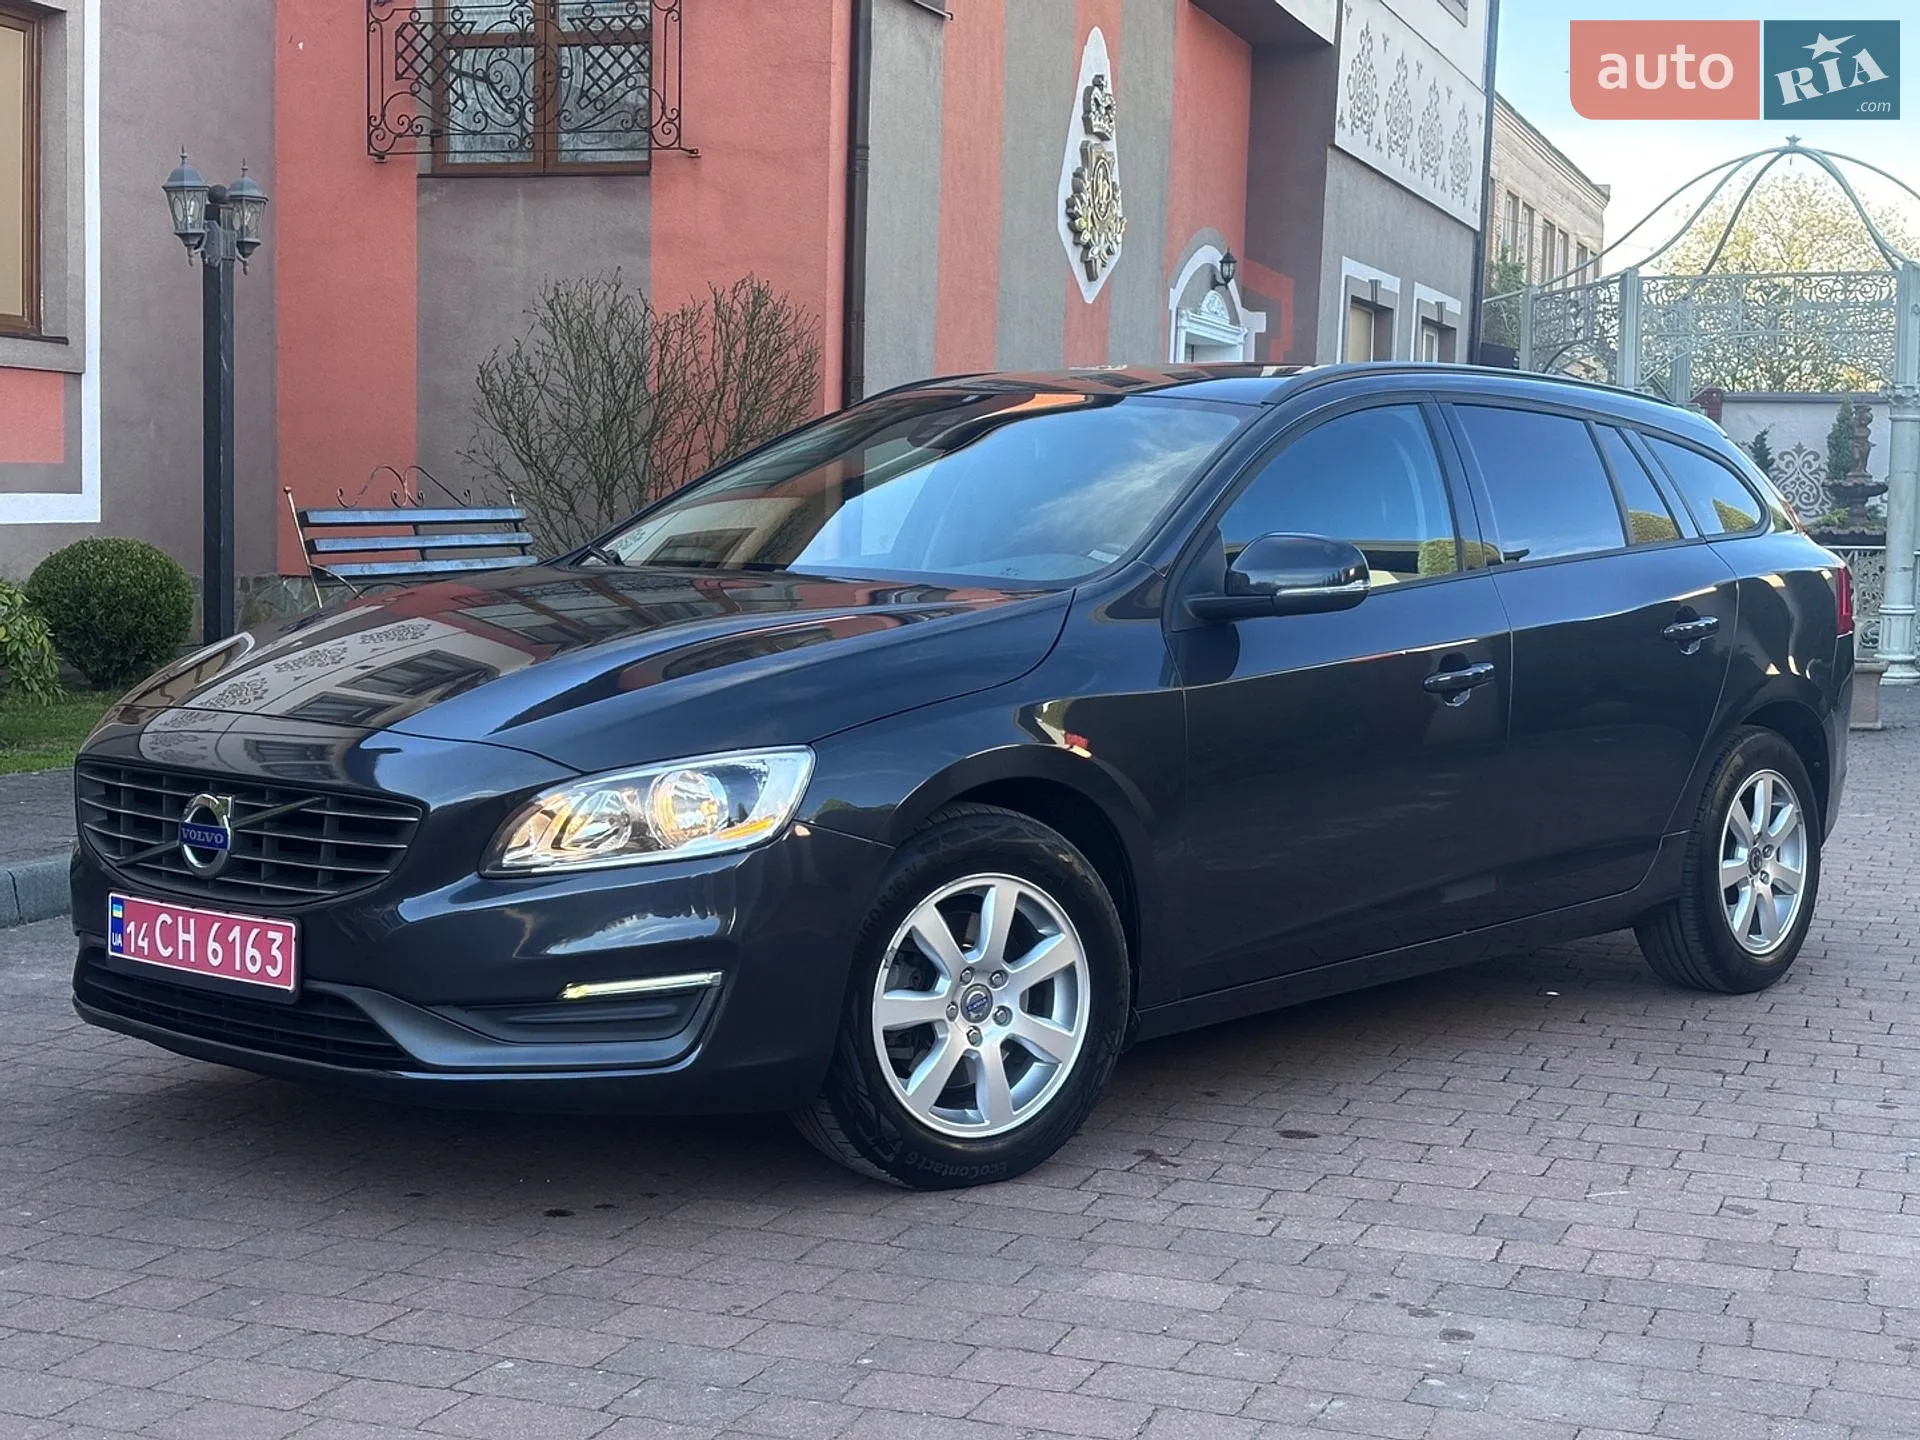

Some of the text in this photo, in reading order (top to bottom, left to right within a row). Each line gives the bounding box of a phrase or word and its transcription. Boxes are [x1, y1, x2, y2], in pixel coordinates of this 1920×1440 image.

[181, 827, 224, 844] VOLVO
[112, 933, 123, 946] UA
[127, 914, 284, 977] 14 CH 6163
